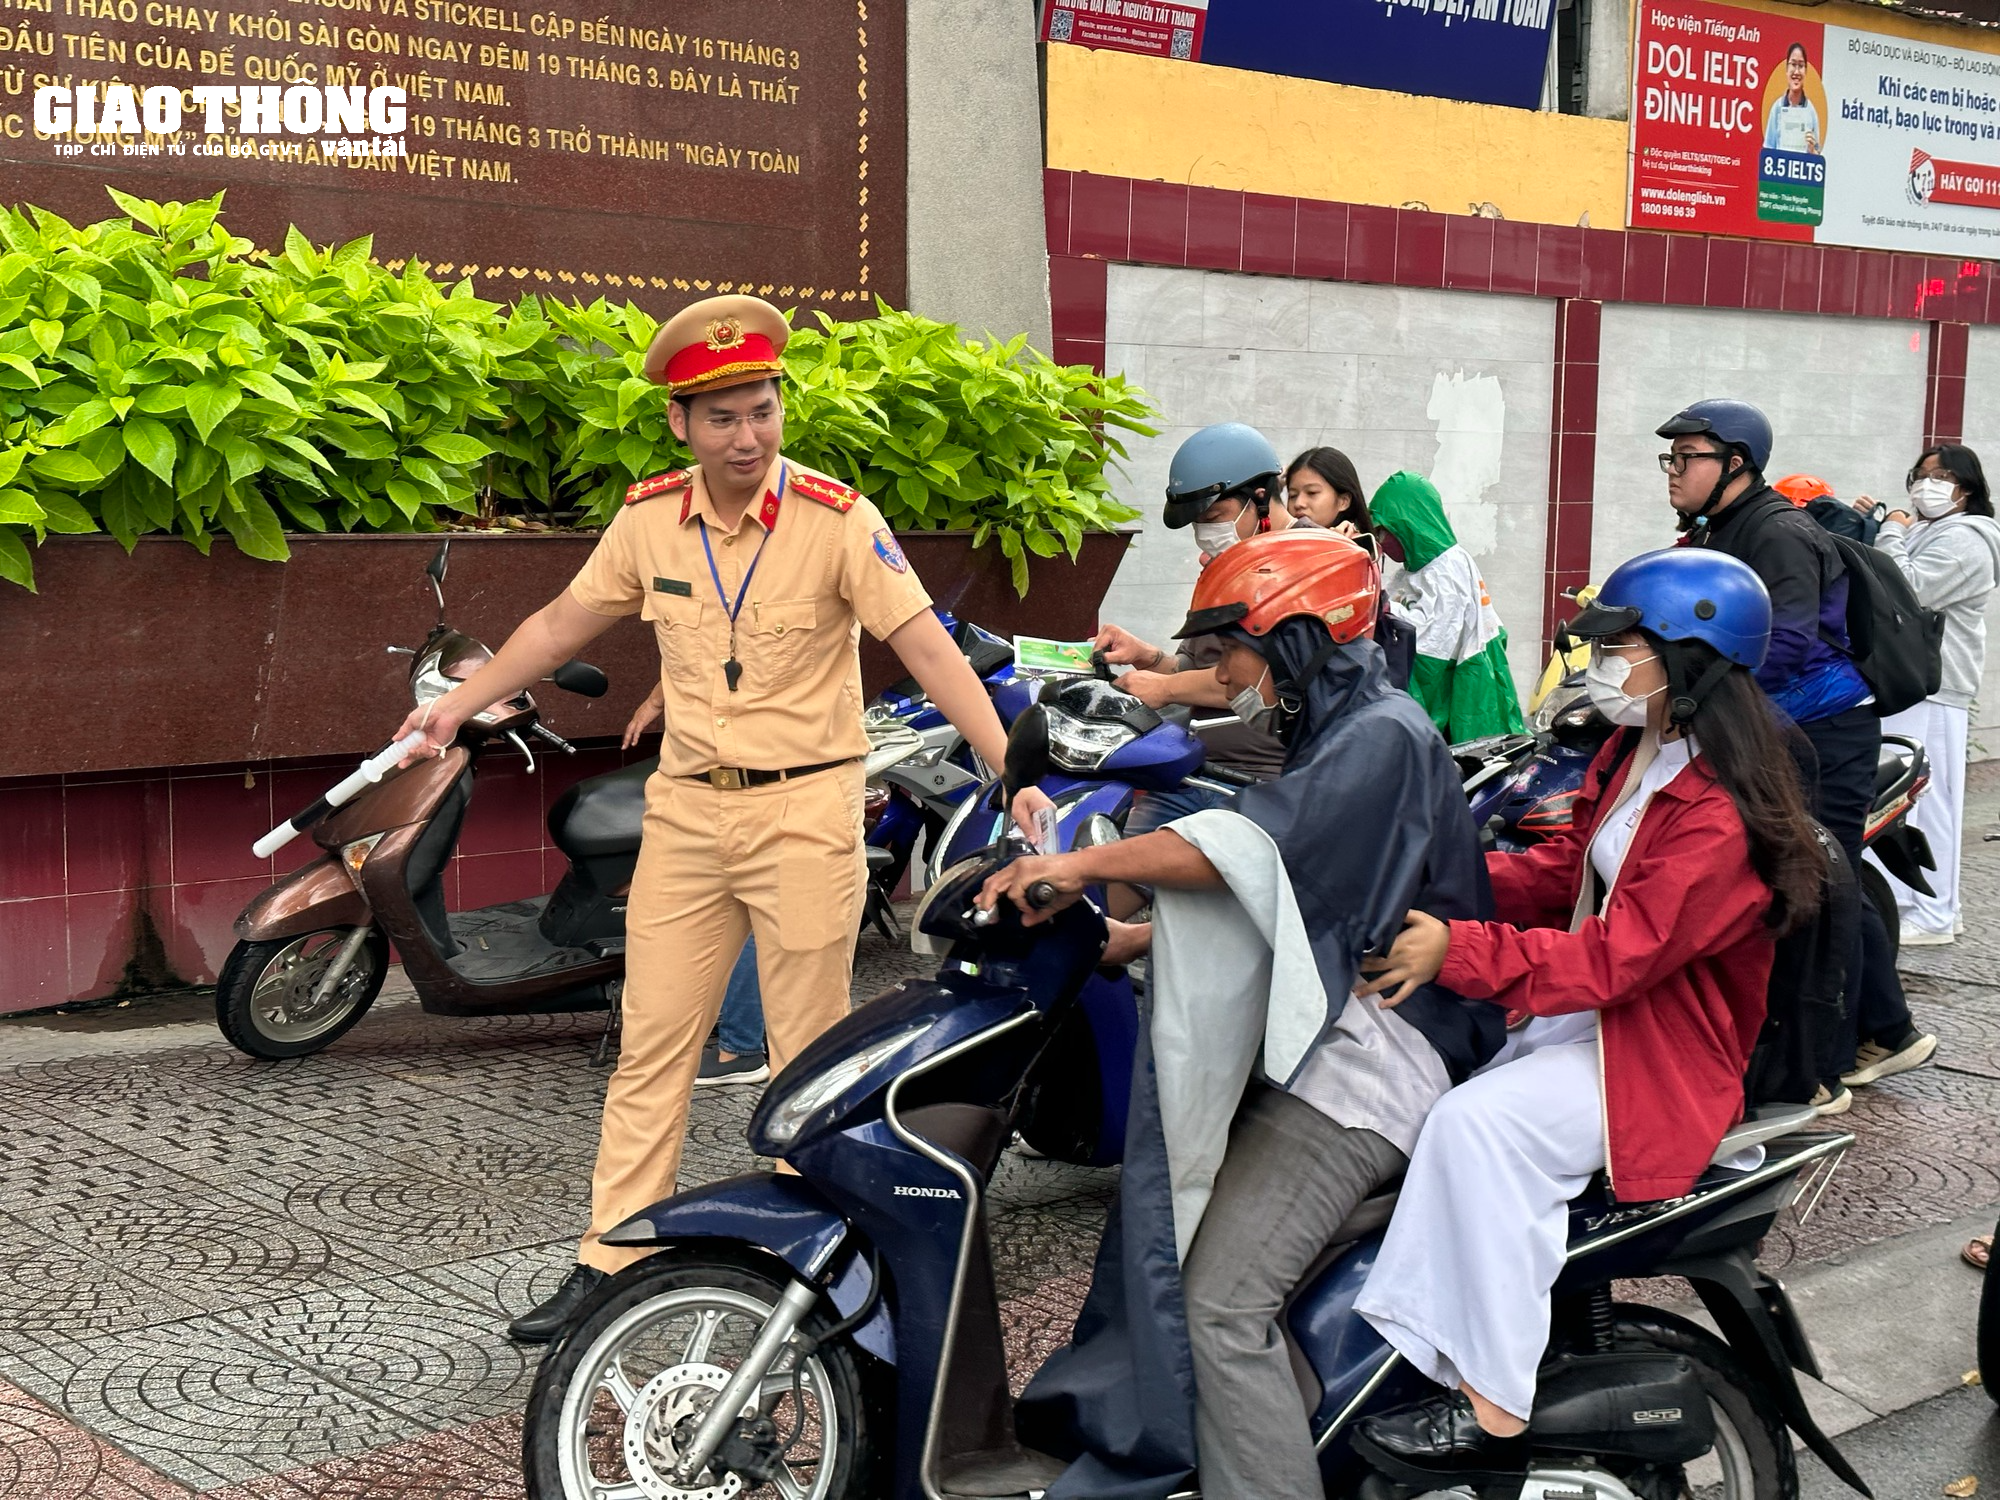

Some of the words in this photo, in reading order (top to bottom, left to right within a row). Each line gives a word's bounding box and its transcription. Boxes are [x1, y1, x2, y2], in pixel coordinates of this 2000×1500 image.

[415, 0, 526, 33] STICKELL
[530, 11, 575, 41] CẬP
[580, 15, 624, 46] BẾN
[630, 26, 687, 54] NGÀY
[692, 37, 714, 58] 16
[717, 38, 785, 68] THÁNG
[790, 50, 799, 70] 3
[1651, 9, 1675, 31] Học
[1677, 14, 1701, 36] viện
[1704, 18, 1736, 43] Tiếng
[1736, 24, 1760, 43] Anh
[0, 19, 54, 55] ĐẦU
[62, 31, 126, 63] TIÊN
[135, 36, 193, 71] CỦA
[200, 44, 236, 76] ĐẾ
[244, 52, 318, 85] QUỐC
[326, 62, 362, 87] MỸ
[370, 62, 388, 90] Ở
[395, 70, 447, 102] VIỆT
[454, 80, 511, 107] NAM.
[146, 2, 219, 34] CHẠY
[228, 9, 291, 42] KHỎI
[299, 18, 339, 48] SÀI
[346, 24, 400, 55] GÒN
[408, 35, 472, 63] NGAY
[480, 42, 529, 71] ĐÊM
[537, 53, 560, 75] 19
[566, 55, 640, 86] THÁNG
[647, 67, 664, 89] 3.
[670, 66, 712, 94] ĐÂY
[718, 72, 743, 98] LÀ
[749, 76, 799, 105] THẤT
[1648, 41, 1697, 80] DOL
[1703, 50, 1759, 90] IELTS
[1849, 38, 1861, 54] BỘ
[1862, 40, 1882, 56] GIÁO
[1884, 45, 1901, 61] DỤC
[1902, 47, 1912, 61] VÀ
[1932, 54, 1947, 69] TẠO
[1954, 56, 1965, 73] BỘ
[1966, 61, 1981, 73] LAO
[0, 64, 25, 95] Ừ
[1878, 75, 1901, 98] Khi
[1903, 81, 1927, 101] các
[1930, 88, 1949, 105] em
[1952, 87, 1964, 111] bị
[1966, 89, 1996, 115] hoặc
[1644, 81, 1703, 127] ĐÌNH
[1709, 97, 1754, 139] LỰC
[1842, 97, 1864, 120] bắt
[1867, 106, 1892, 129] nạt,
[1896, 107, 1920, 132] bạo
[1922, 111, 1942, 135] lực
[1945, 115, 1977, 141] trong
[1981, 121, 1994, 139] và
[411, 114, 436, 137] 19
[442, 115, 522, 146] THÁNG
[528, 127, 540, 148] 3
[546, 124, 591, 153] TRỞ
[597, 132, 669, 161] THÀNH
[747, 148, 799, 174] TOÀN
[405, 149, 456, 180] VIỆT
[462, 158, 518, 184] NAM.
[1764, 156, 1786, 177] 8.5
[1788, 159, 1823, 182] IELTS
[1941, 171, 1964, 191] HÃY
[1965, 176, 1984, 197] GỌI
[1641, 187, 1726, 206] www.dolenglish.vn
[1641, 203, 1661, 215] 1800
[1685, 207, 1696, 218] 39
[893, 1185, 961, 1199] HONDA
